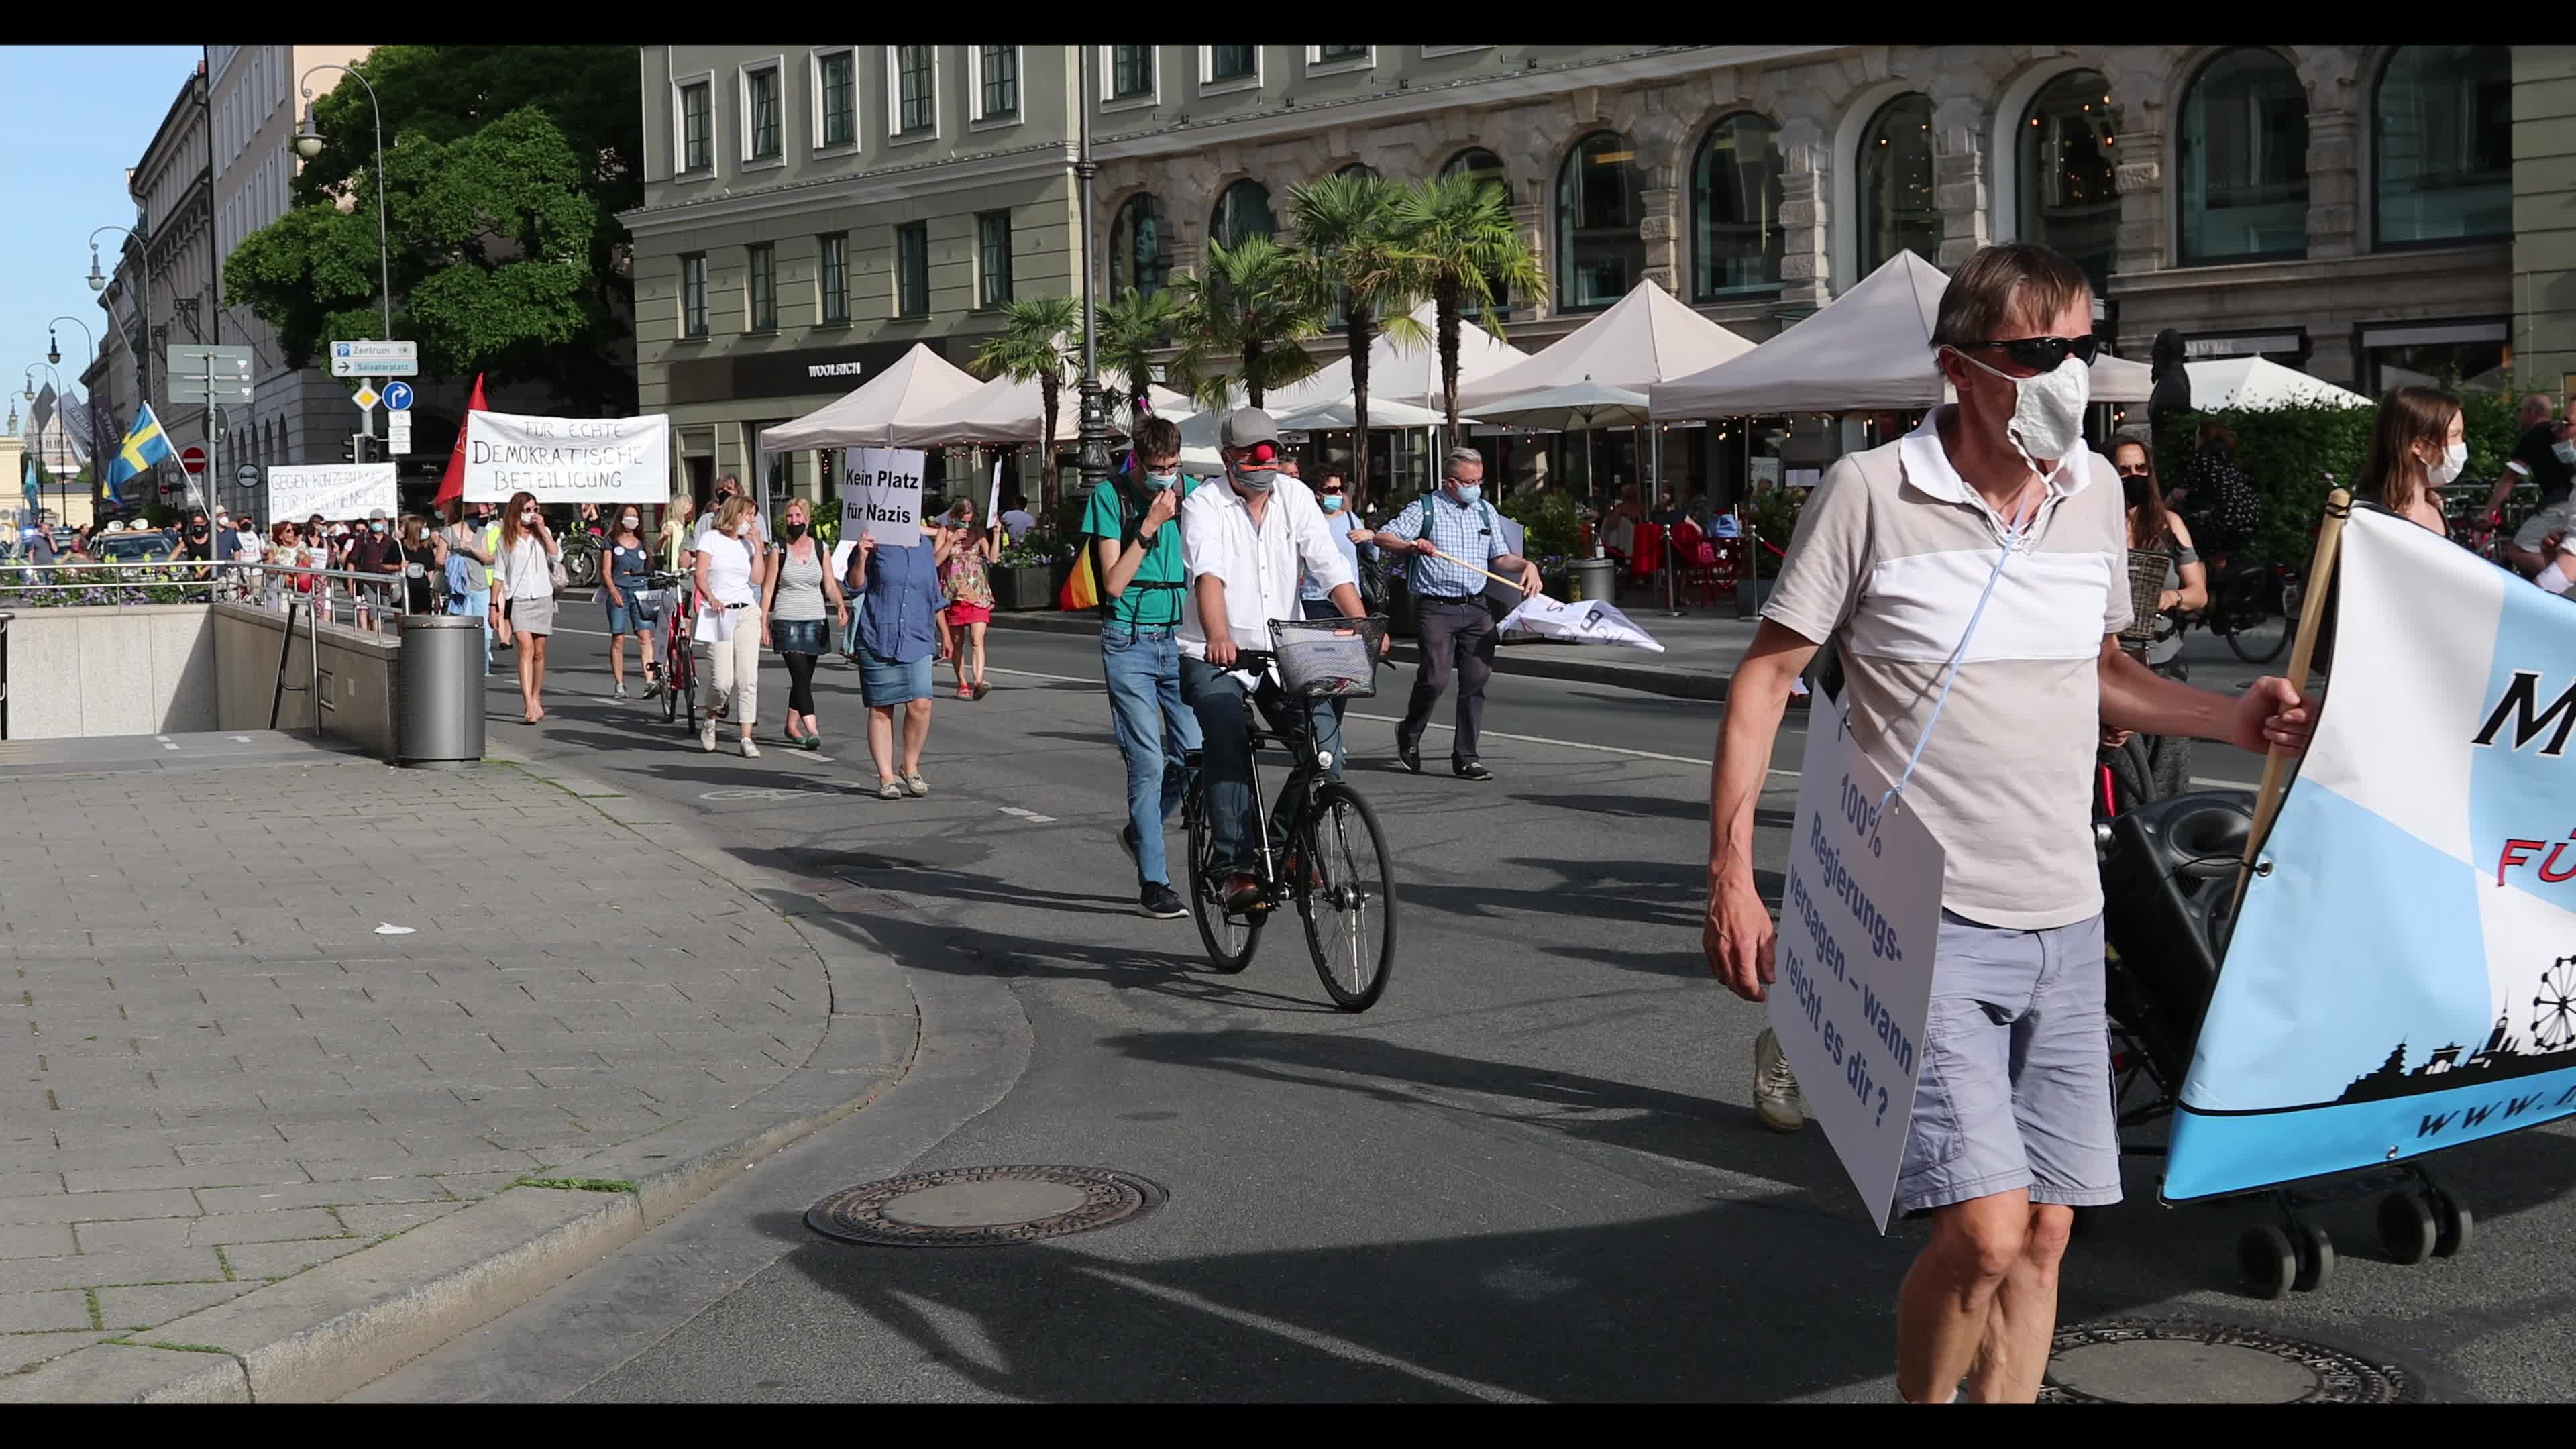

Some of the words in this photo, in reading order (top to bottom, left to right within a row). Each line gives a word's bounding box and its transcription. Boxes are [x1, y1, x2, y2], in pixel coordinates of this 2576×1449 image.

[354, 346, 390, 355] Zentrum
[357, 362, 409, 372] Salvatorplatz
[808, 362, 861, 377] WOOLRICH
[525, 421, 555, 439] FÜR
[568, 423, 624, 439] ECHTE
[472, 440, 643, 466] DEMOKRATISCHE
[271, 474, 309, 491] GEGEN
[845, 468, 873, 486] Kein
[877, 470, 919, 490] Platz
[847, 502, 863, 520] für
[865, 504, 911, 524] Nazis
[1840, 771, 1883, 859] 100%
[1810, 810, 1903, 962] Regierungs-
[1788, 863, 1846, 978] versagen
[1862, 985, 1914, 1077] wann
[1785, 944, 1822, 1034] reicht
[1823, 1021, 1843, 1067] es
[1847, 1053, 1874, 1108] dir
